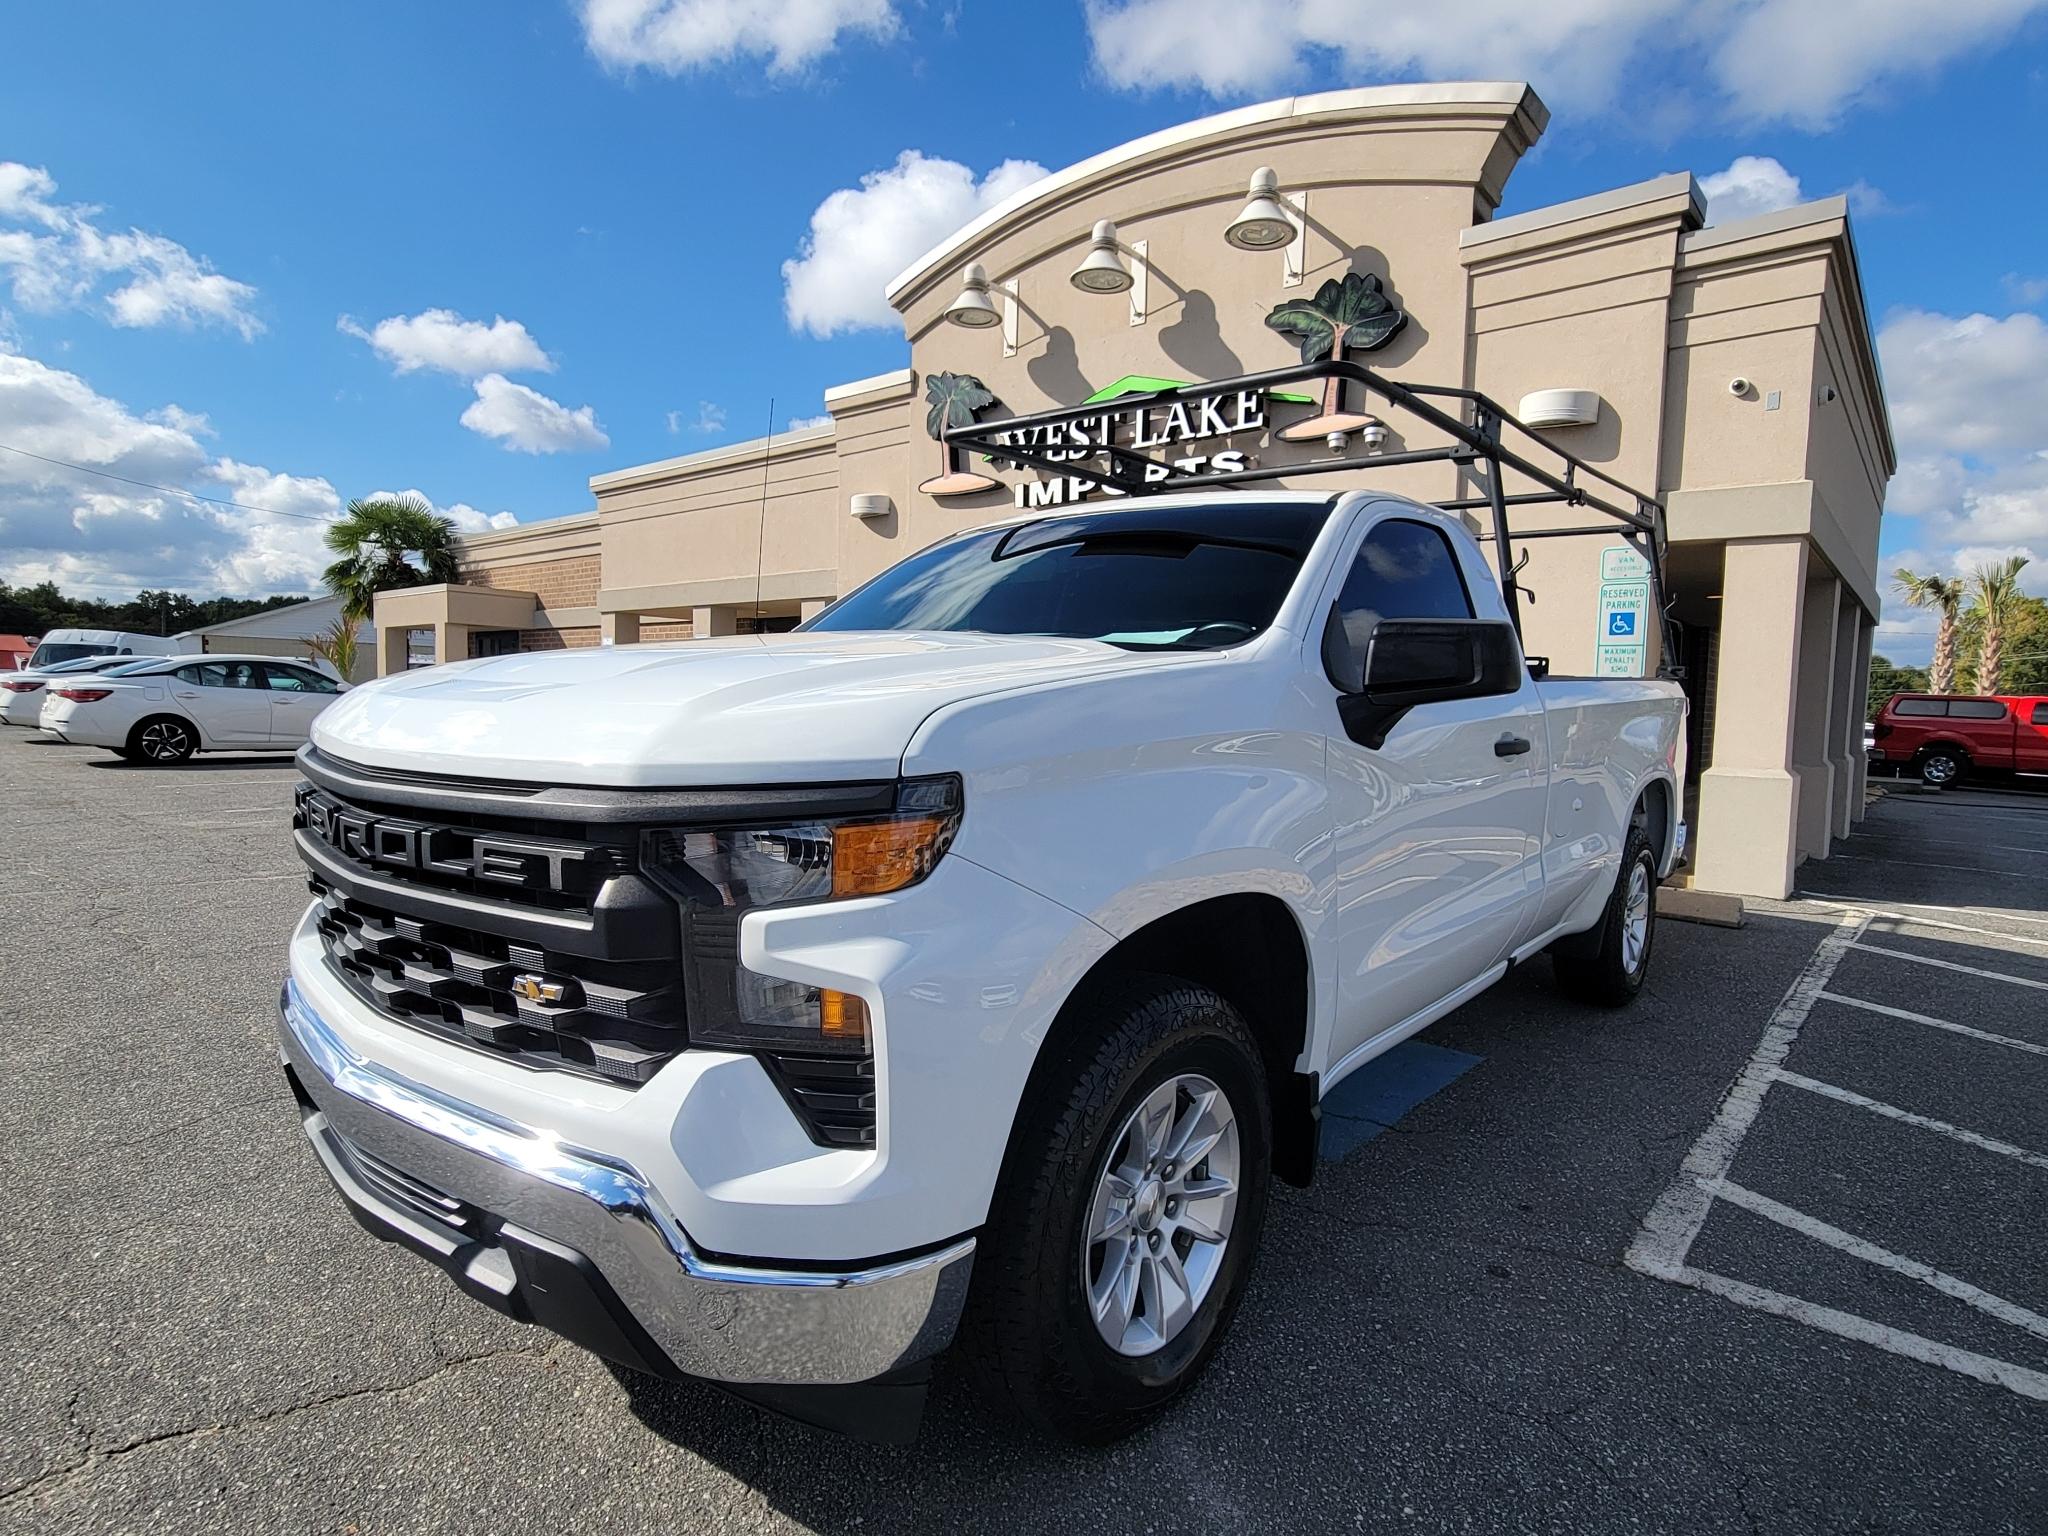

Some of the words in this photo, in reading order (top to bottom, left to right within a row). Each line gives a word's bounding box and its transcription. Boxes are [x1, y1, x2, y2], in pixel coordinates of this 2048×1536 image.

[1000, 412, 1120, 470] WEST
[1131, 388, 1264, 449] LAKE
[1013, 449, 1245, 508] IMPRTS
[1603, 589, 1645, 598] RESERVED
[1606, 600, 1641, 609] PARKING
[1604, 656, 1635, 664] PENALTY
